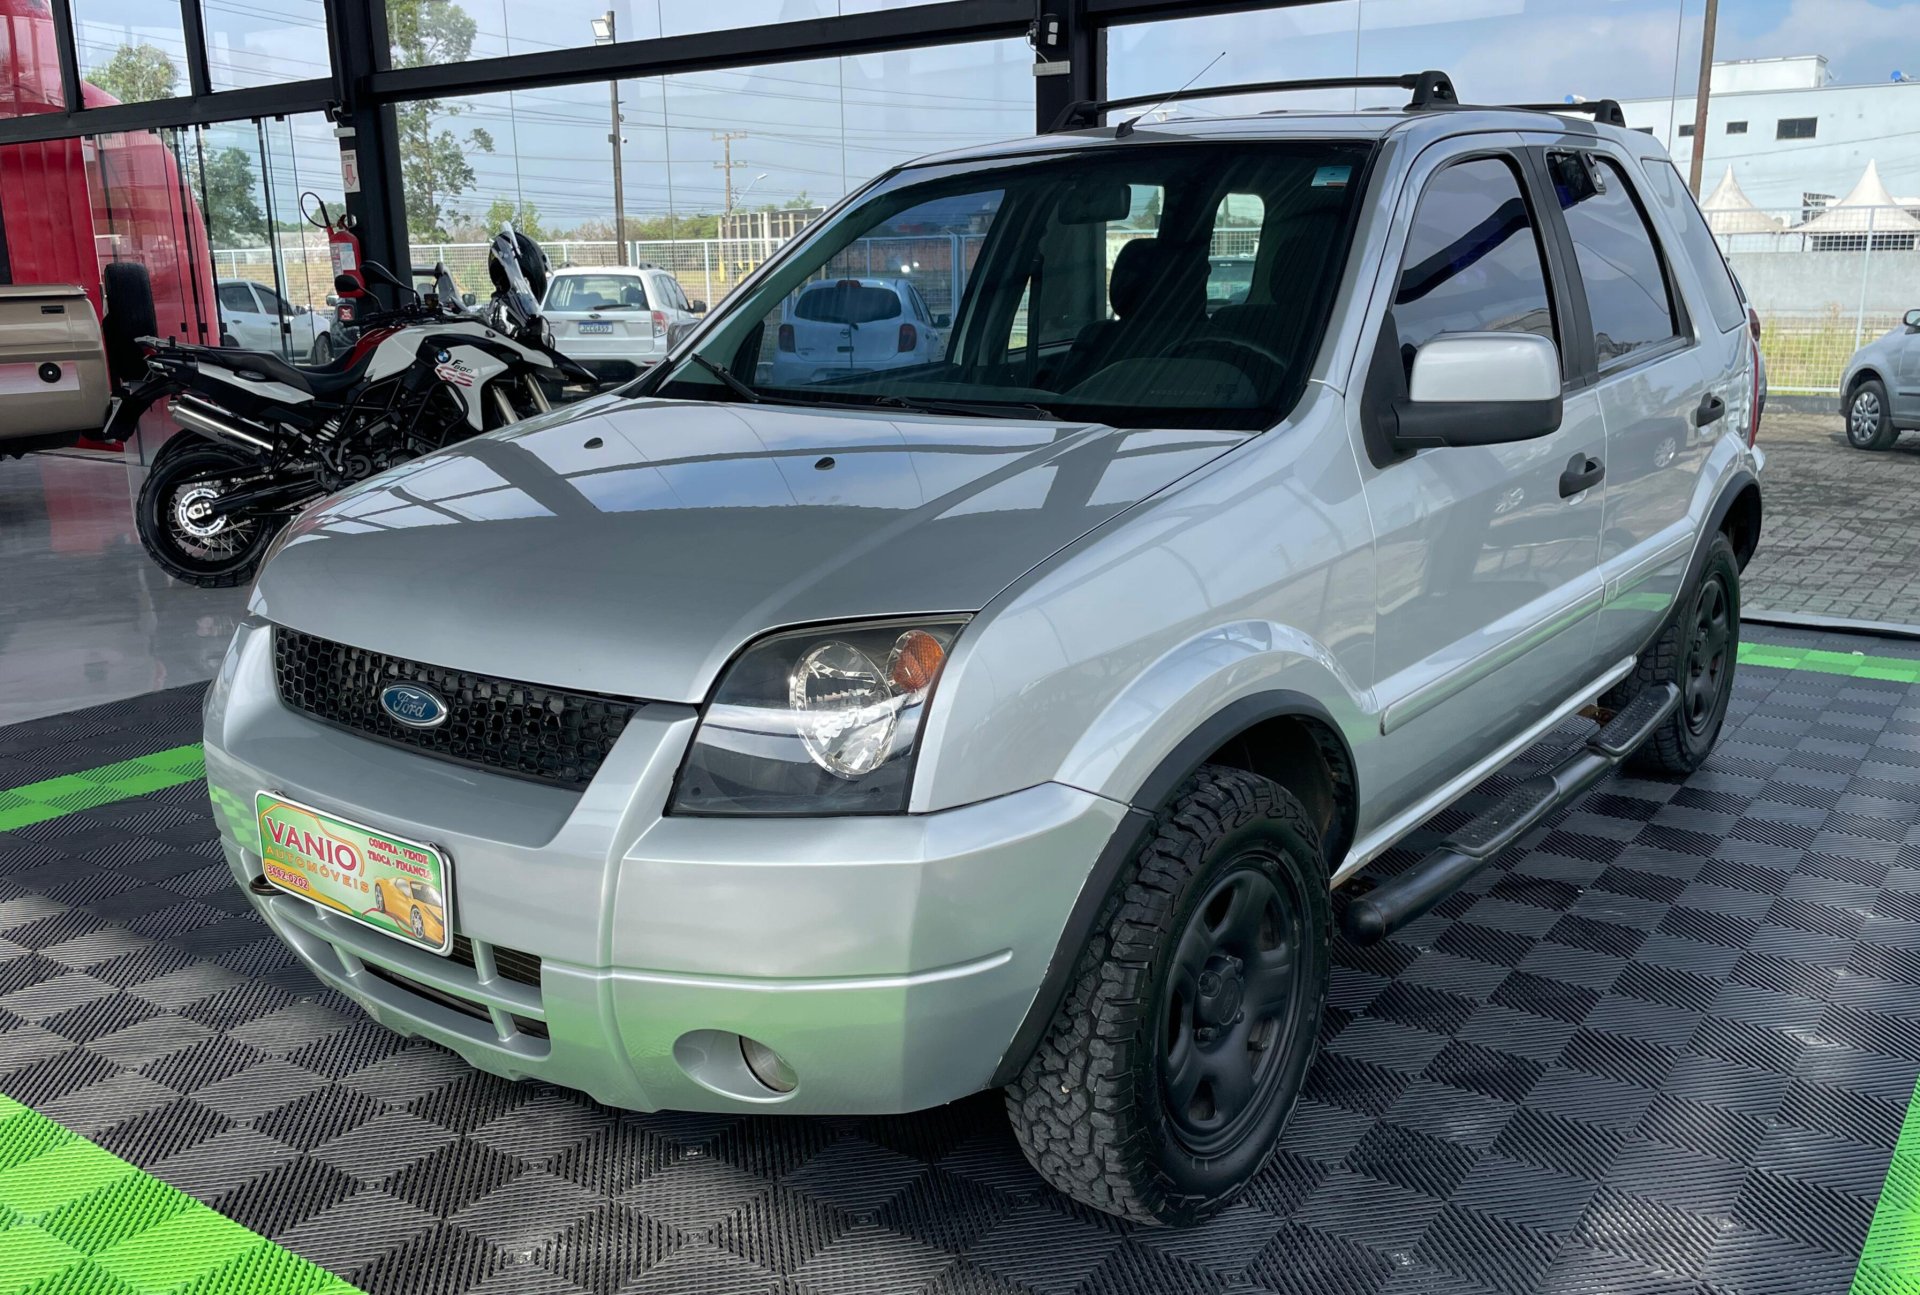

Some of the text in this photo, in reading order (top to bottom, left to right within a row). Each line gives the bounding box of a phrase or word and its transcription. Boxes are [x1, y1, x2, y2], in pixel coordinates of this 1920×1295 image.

[393, 691, 427, 718] Ford
[266, 817, 357, 871] VANIO
[367, 850, 391, 866] TROCA
[368, 837, 429, 865] COMPRA VENDE
[266, 845, 370, 894] AUTOMÓVEIS
